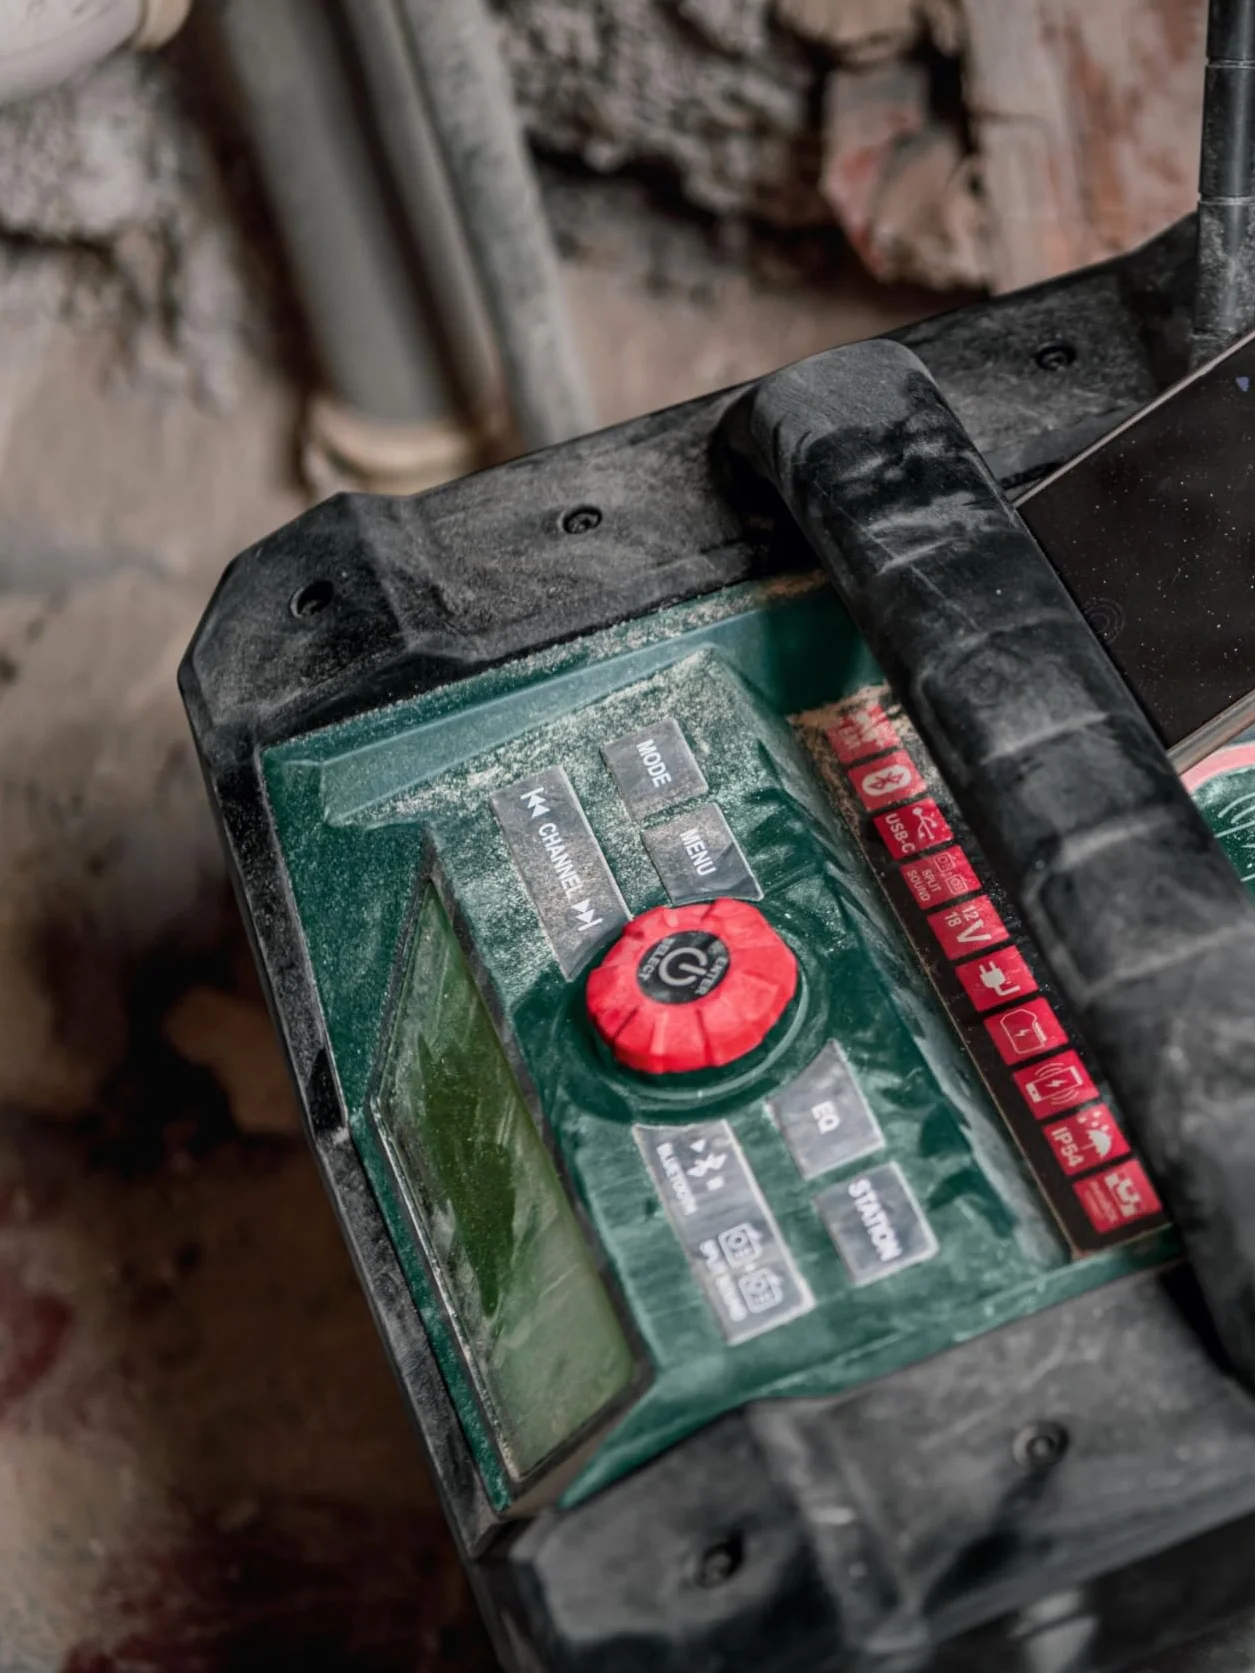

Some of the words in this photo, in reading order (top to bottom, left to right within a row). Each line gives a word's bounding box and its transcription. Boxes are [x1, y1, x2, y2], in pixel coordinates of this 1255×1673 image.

[636, 738, 672, 788] MODE
[679, 828, 717, 877] MENU
[884, 813, 916, 854] USB-C
[538, 822, 583, 899] CHANNEL
[921, 868, 942, 893] SPLIT
[906, 870, 931, 902] SOUND
[943, 912, 962, 928] 18
[956, 918, 992, 944] V
[961, 904, 979, 921] 12
[637, 938, 675, 982] SELECT
[695, 954, 730, 996] ENTER
[810, 1100, 840, 1135] EQ
[1051, 1126, 1085, 1168] IP54
[848, 1178, 902, 1262] STATION
